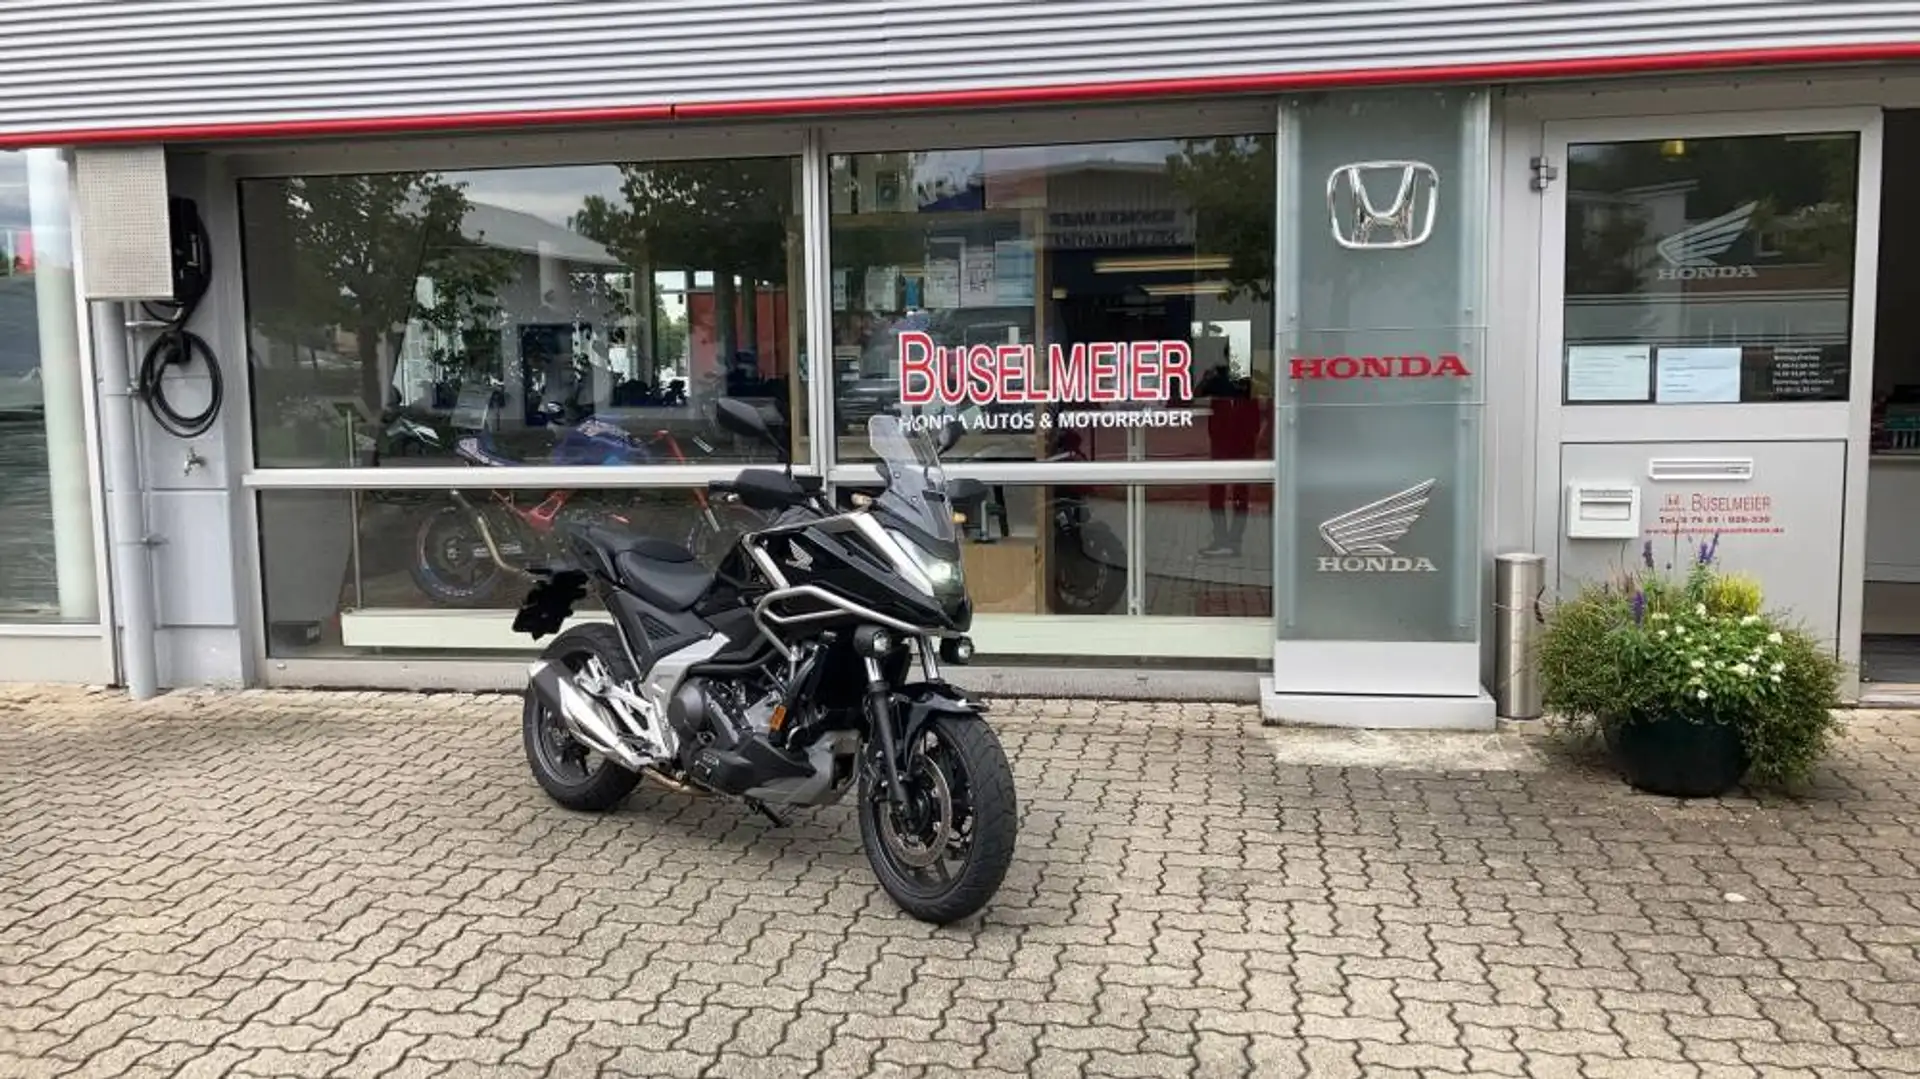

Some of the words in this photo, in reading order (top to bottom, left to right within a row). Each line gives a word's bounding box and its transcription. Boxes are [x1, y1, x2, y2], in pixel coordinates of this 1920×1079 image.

[1657, 264, 1759, 280] HONDA
[898, 331, 1193, 404] BUSELMEIER
[1290, 355, 1472, 379] HONDA
[973, 412, 1034, 430] AUTOS
[1039, 413, 1053, 429] &
[1058, 408, 1193, 428] MOTORRÄDER
[1317, 556, 1438, 573] HONDA
